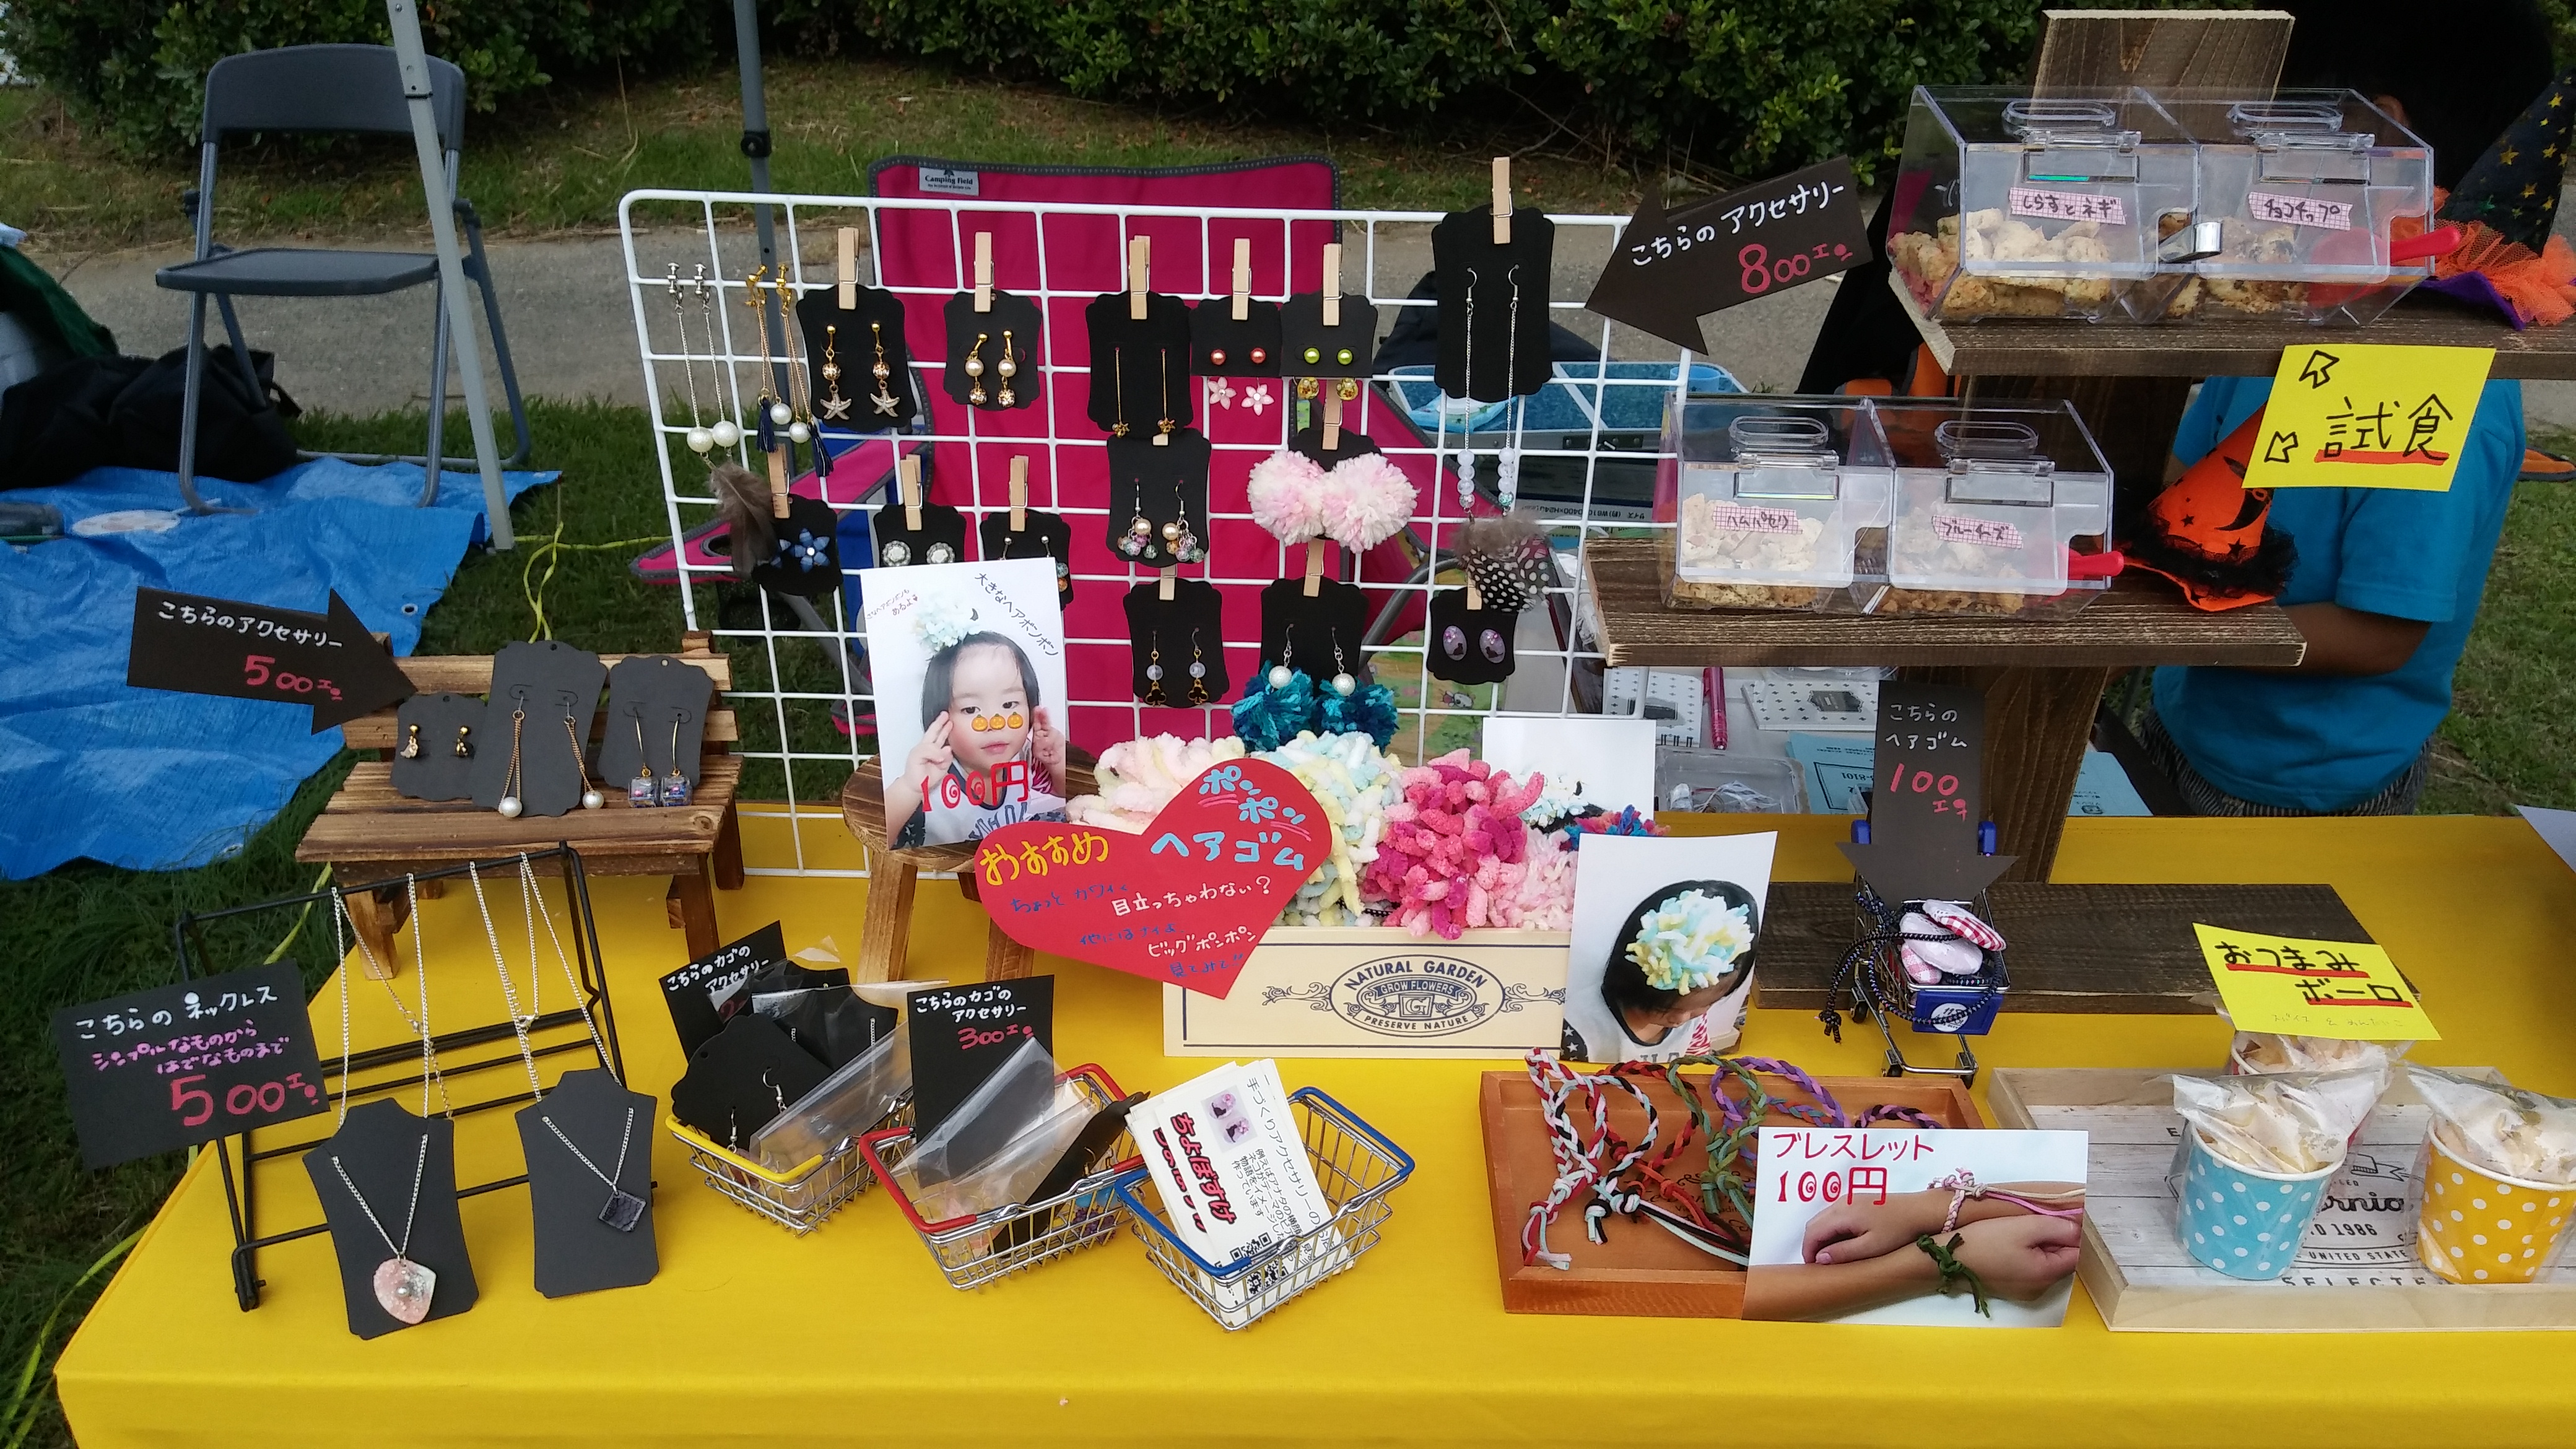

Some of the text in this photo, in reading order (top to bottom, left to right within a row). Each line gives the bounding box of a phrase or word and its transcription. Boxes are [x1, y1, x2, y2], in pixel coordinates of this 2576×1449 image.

[925, 175, 955, 184] Camping
[2024, 194, 2117, 218] しらすとネギ
[2265, 199, 2341, 223] チョコチップ
[1631, 180, 1845, 267] こちらのアクセサリー
[2323, 393, 2453, 461] 試食
[157, 601, 344, 649] こちらのアクセサリー
[1889, 702, 1958, 722] こちらの
[1885, 731, 1968, 751] ヘアゴム
[920, 760, 1029, 812] 100円
[1889, 763, 1959, 796] 100
[1150, 830, 1305, 871] ヘアゴム
[1147, 925, 1257, 958] ビッグポンポン
[2214, 941, 2361, 972] おつまみ
[666, 945, 751, 992] こちらのカゴの
[704, 957, 770, 994] アクセサリー
[1344, 960, 1488, 990] NATURAL GARDEN
[915, 985, 1012, 1014] こちらのカゴの
[1380, 980, 1455, 994] GROW FLOWERS
[2294, 978, 2403, 1003] ボーロ
[951, 1004, 1027, 1024] アクセサリー
[1364, 1015, 1469, 1030] PRESERVE NATURE
[156, 1036, 290, 1075] はでなものまで
[1773, 1133, 1935, 1162] ブレスレット
[1170, 1112, 1238, 1225] ちょぼすけ
[1231, 1160, 1265, 1217] 作っています
[1777, 1166, 1888, 1206] 100円
[2331, 1224, 2378, 1236] 1986
[2309, 1250, 2360, 1261] UNITED
